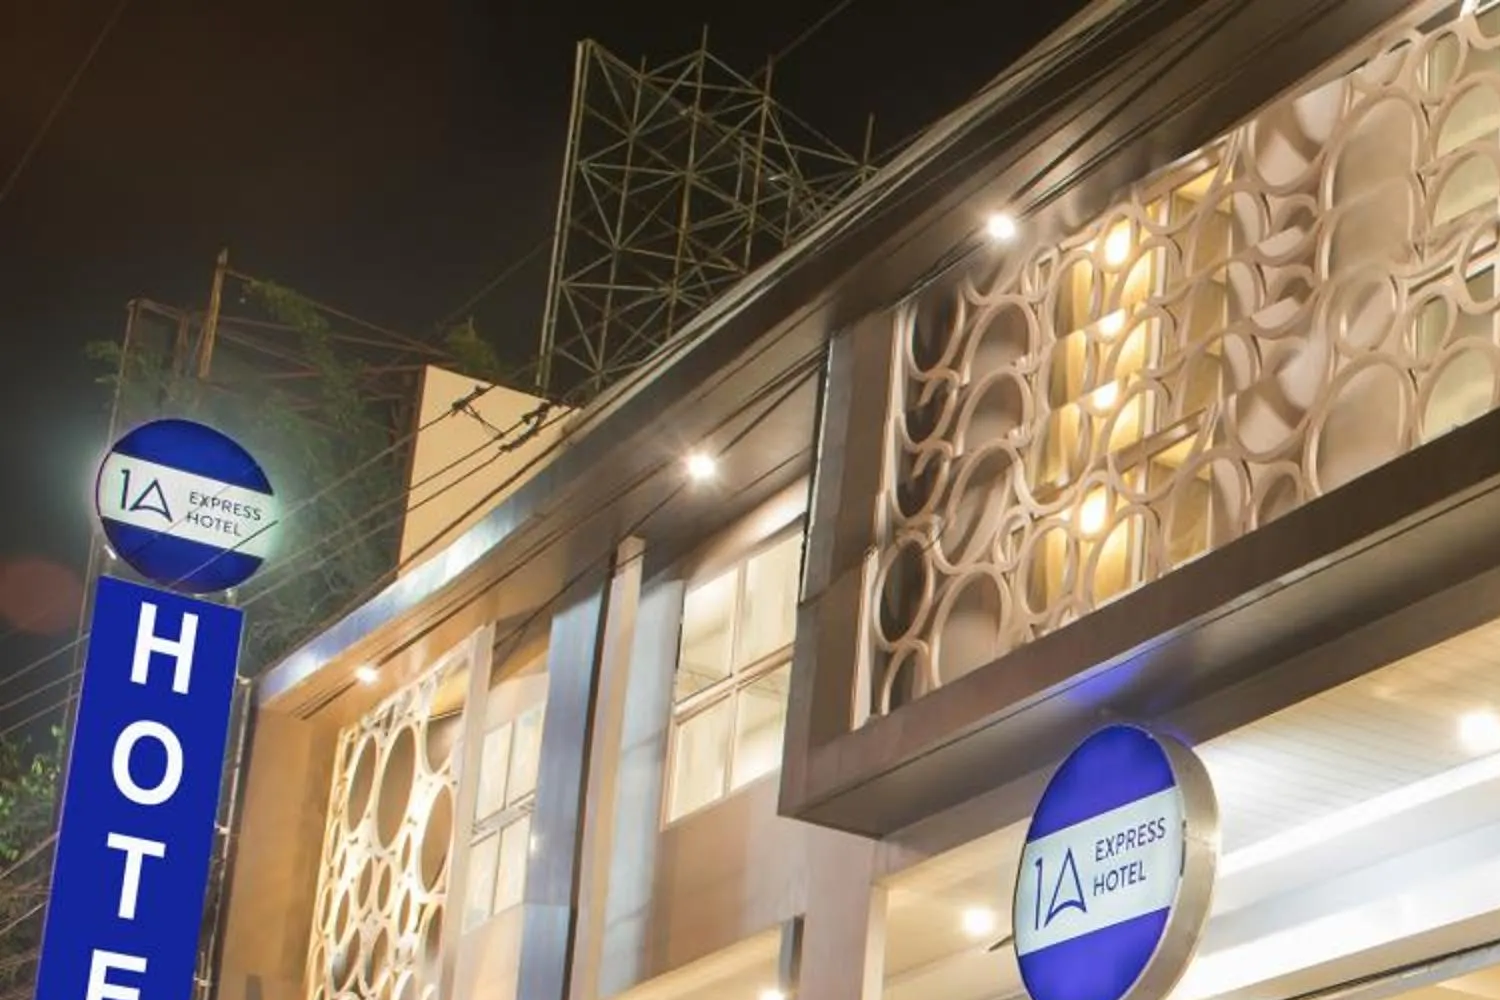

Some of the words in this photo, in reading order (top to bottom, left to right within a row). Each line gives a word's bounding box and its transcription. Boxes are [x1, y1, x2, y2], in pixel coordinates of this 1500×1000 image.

[189, 491, 262, 522] EXPRESS
[186, 511, 242, 537] HOTEL
[1095, 817, 1166, 862] EXPRESS
[1093, 860, 1147, 897] HOTEL
